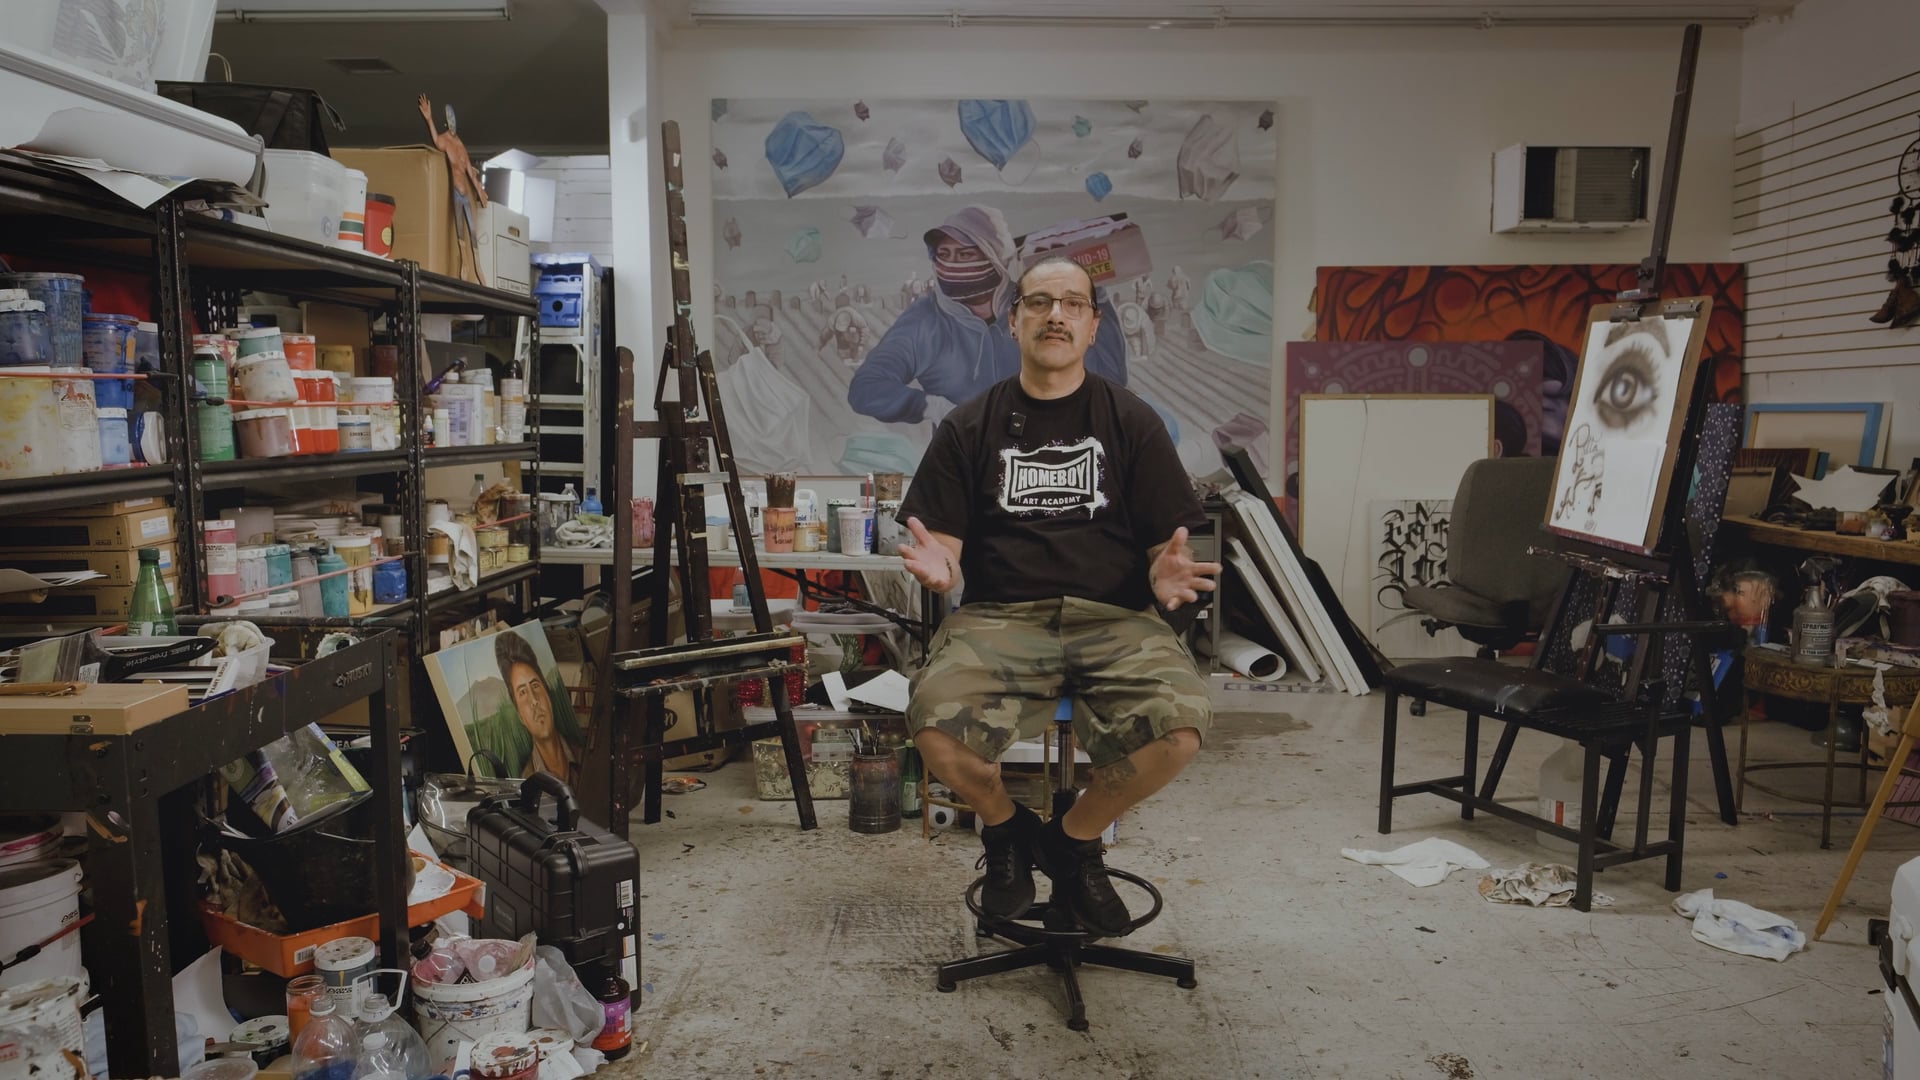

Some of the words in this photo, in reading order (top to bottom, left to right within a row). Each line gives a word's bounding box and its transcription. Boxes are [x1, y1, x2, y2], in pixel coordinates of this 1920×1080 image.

[1017, 461, 1086, 491] HOMEBOY
[1022, 497, 1039, 505] ART
[1041, 495, 1081, 505] ACADEMY
